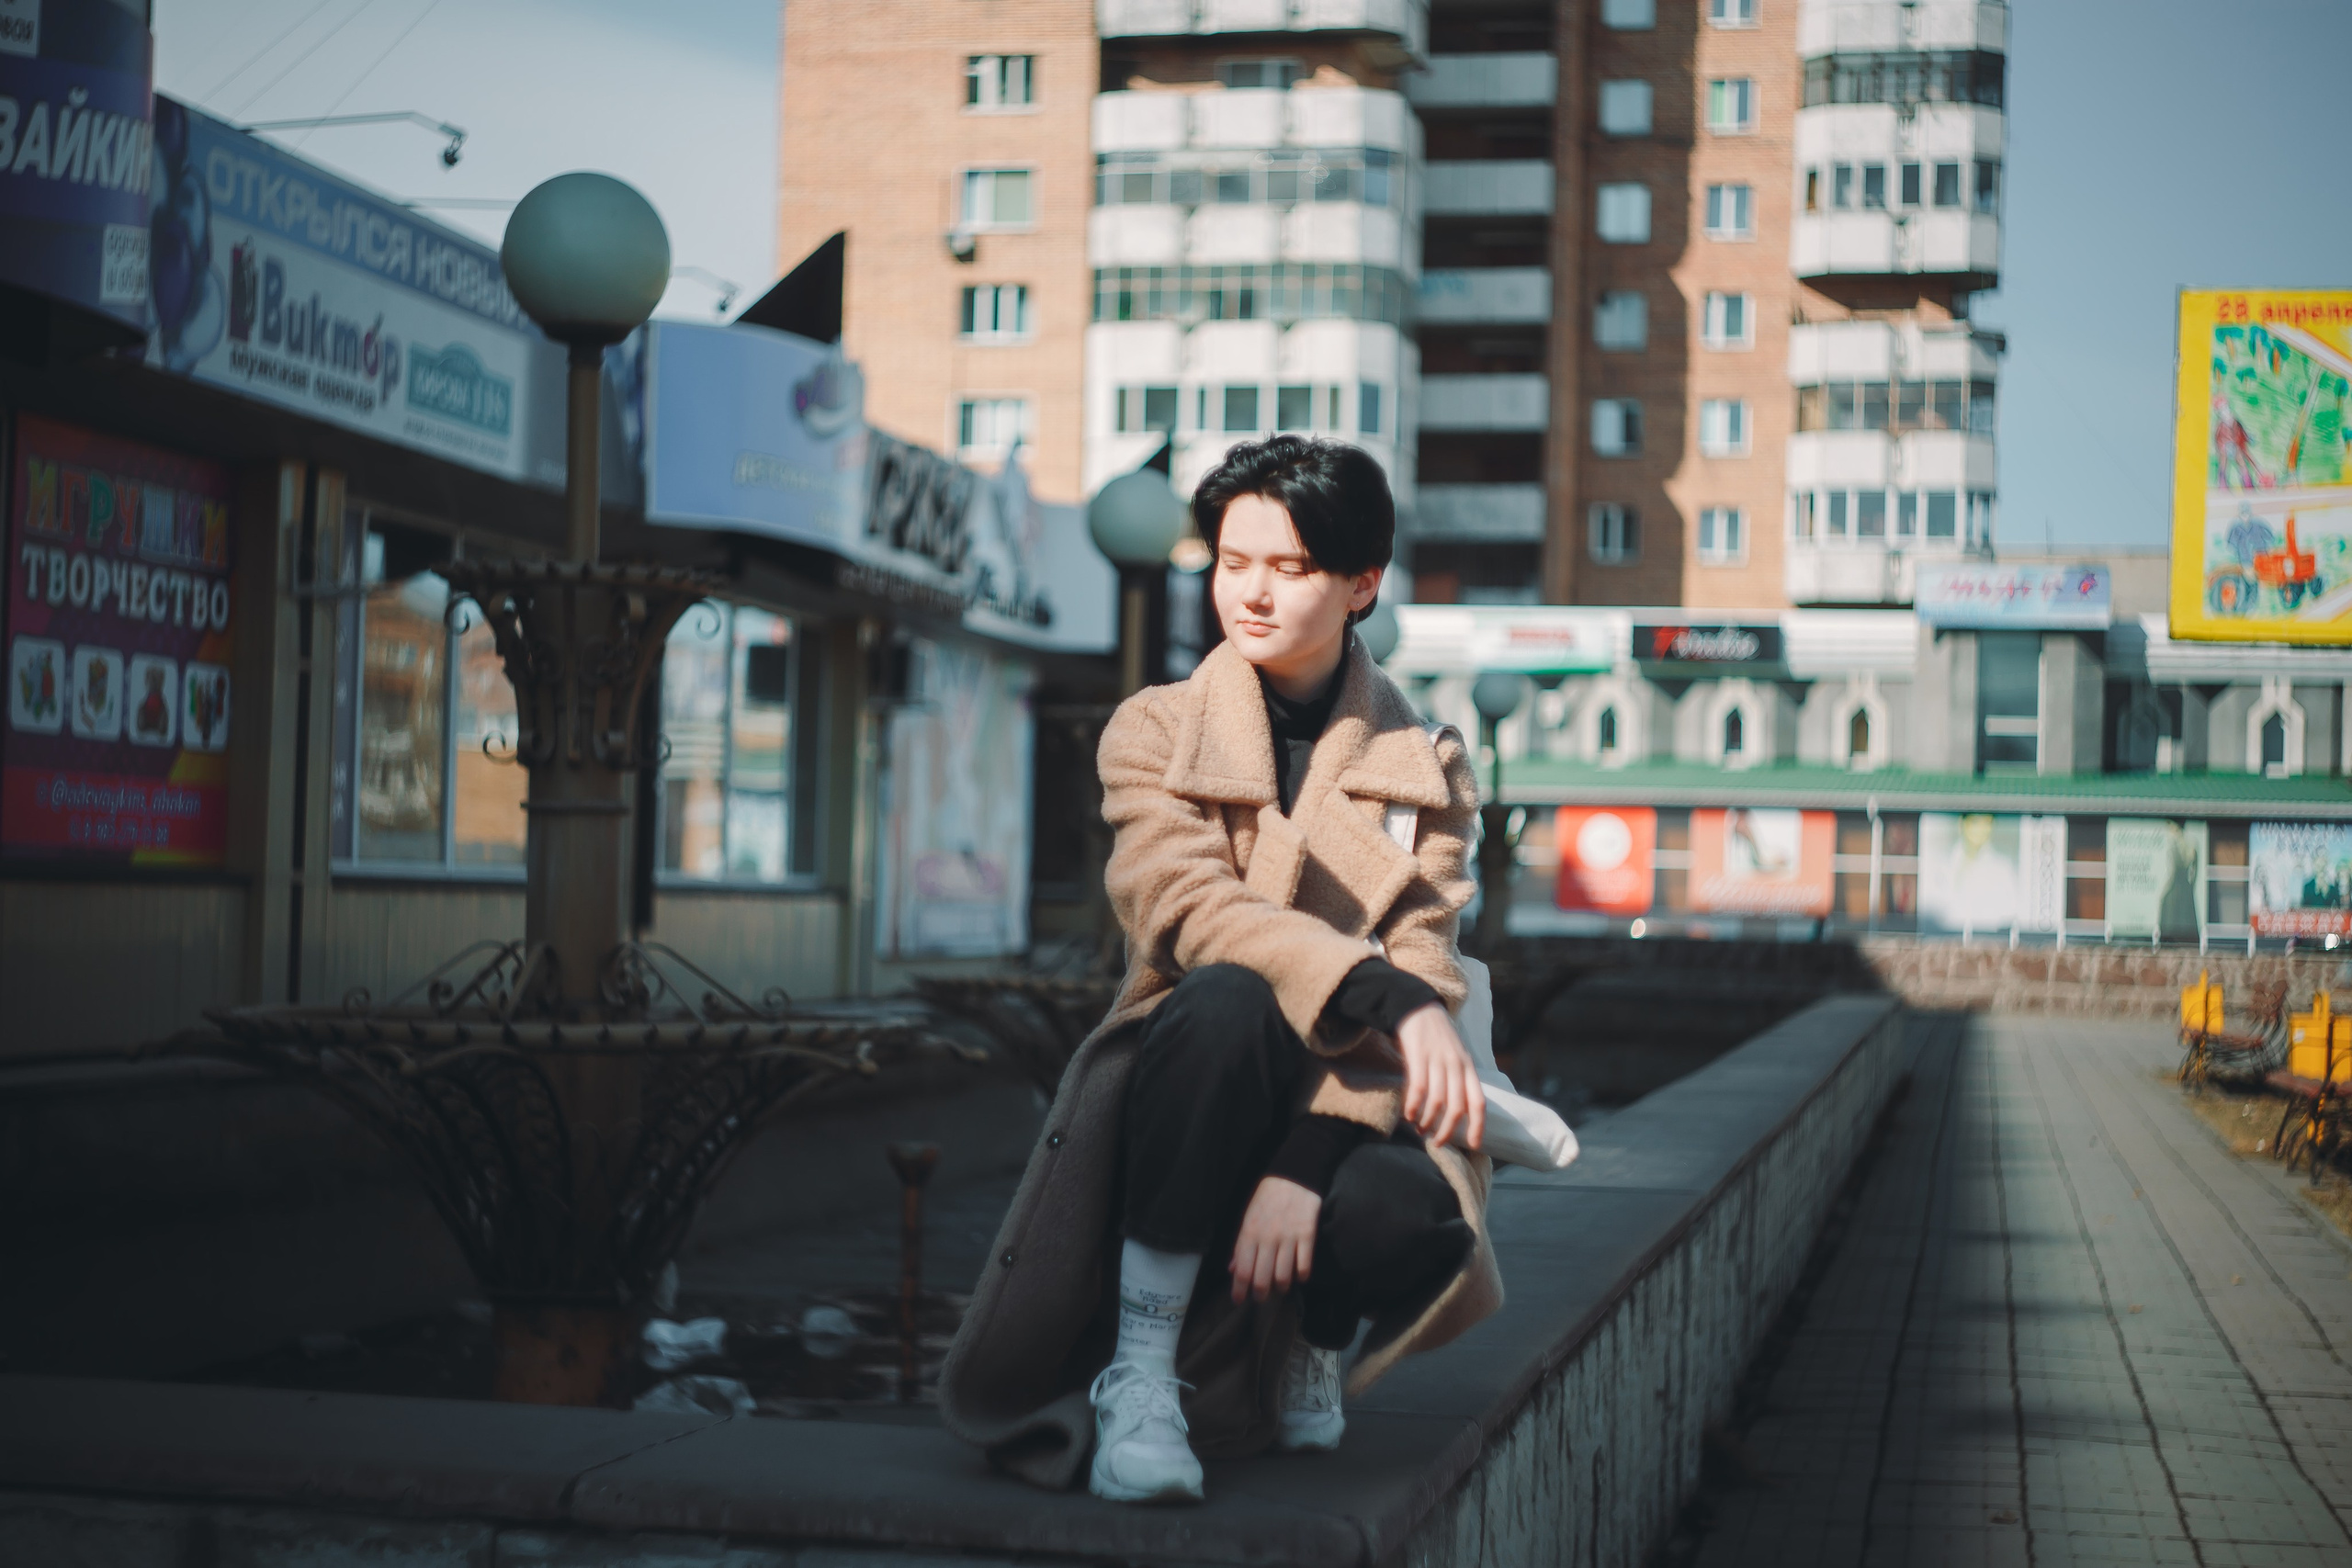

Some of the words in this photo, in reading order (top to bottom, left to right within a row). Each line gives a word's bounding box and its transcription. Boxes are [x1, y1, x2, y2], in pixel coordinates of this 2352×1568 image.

[206, 144, 413, 283] ОТКРЫЛСЯ
[26, 455, 229, 567] ИГРУШКИ
[22, 541, 229, 632] ТВОРЧЕСТВО
[1139, 1289, 1182, 1300] Edgware
[1142, 1296, 1168, 1304] Road
